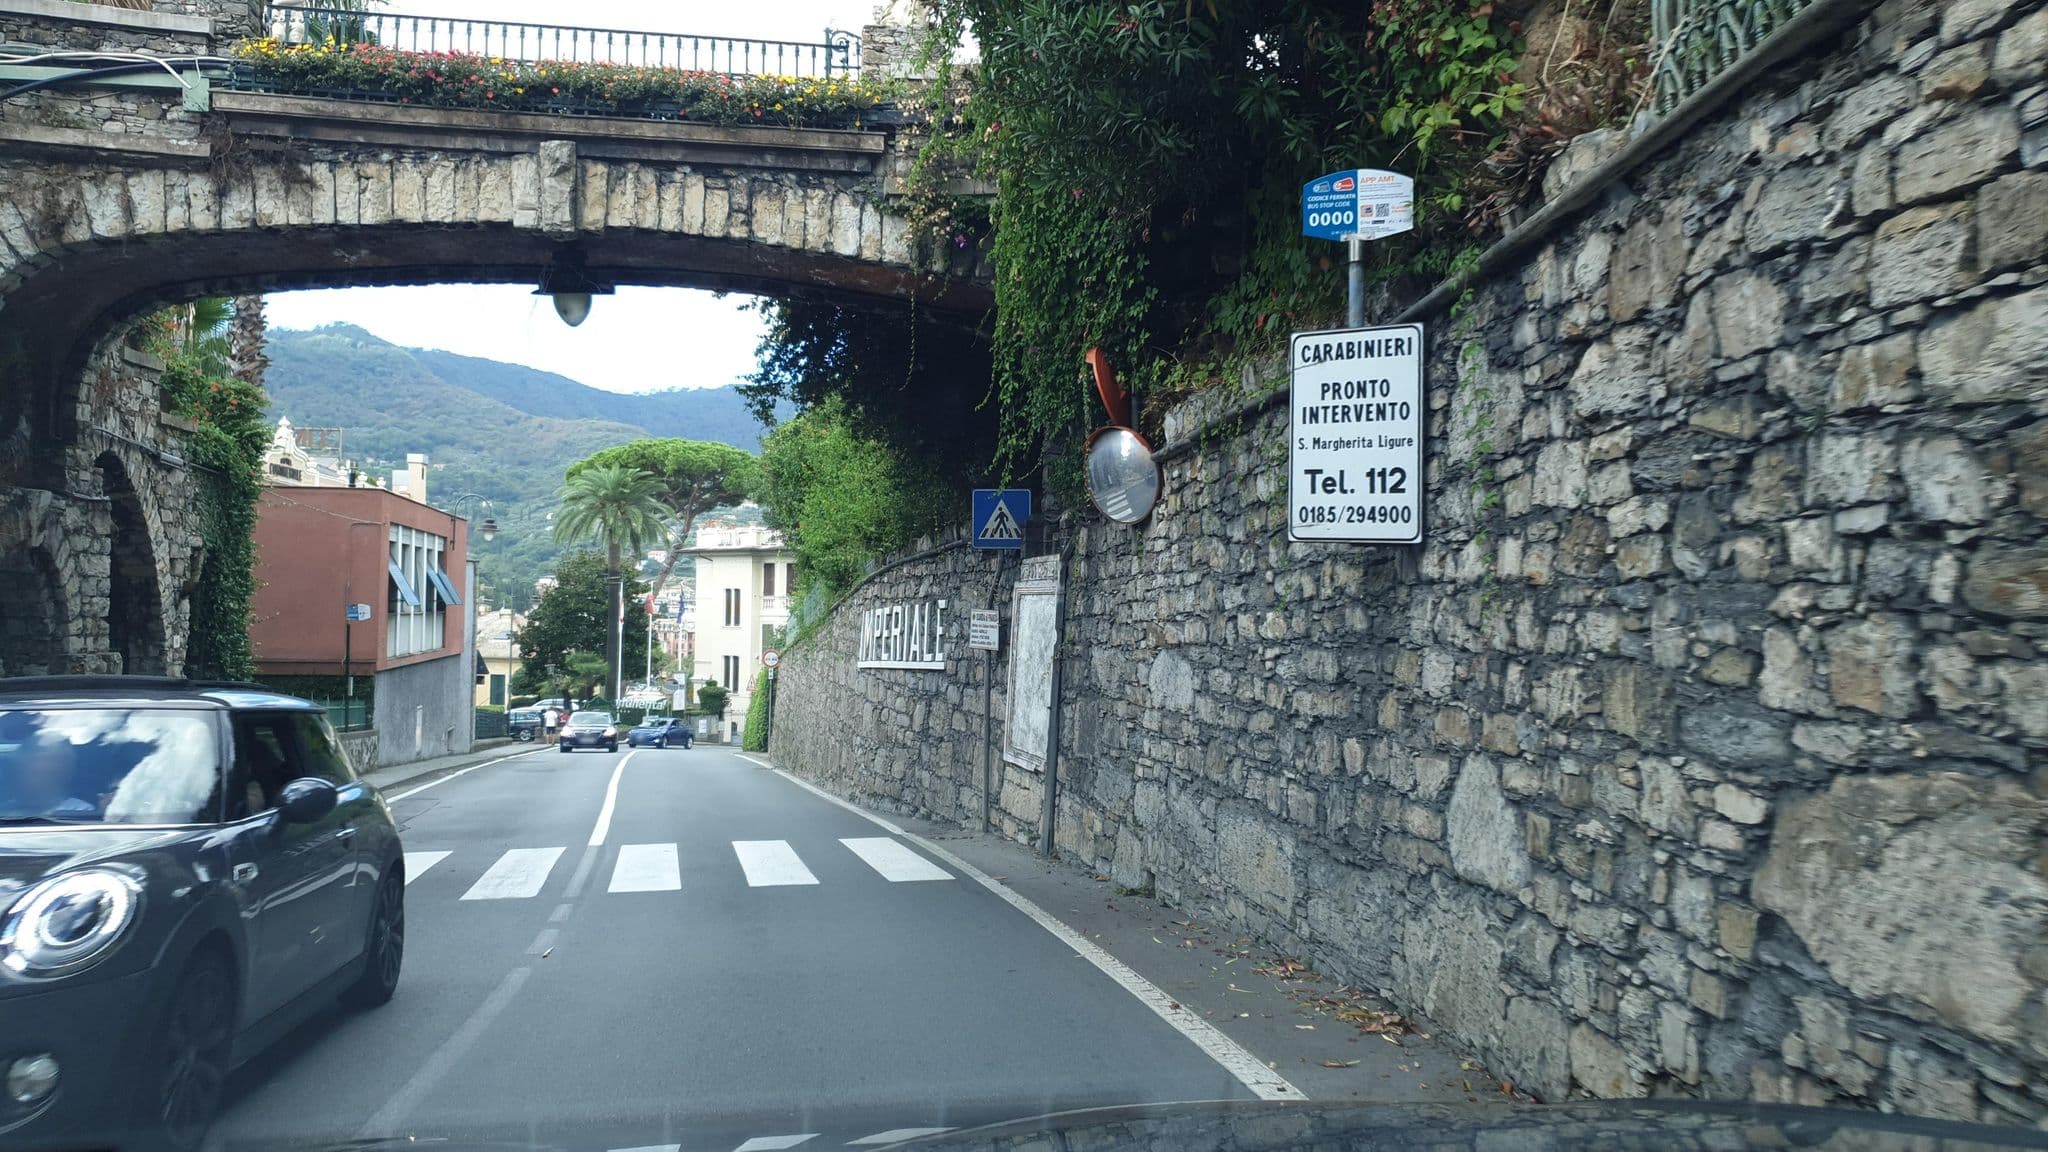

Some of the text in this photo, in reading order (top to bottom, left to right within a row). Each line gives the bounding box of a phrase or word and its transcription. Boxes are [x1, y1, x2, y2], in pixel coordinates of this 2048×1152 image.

[1360, 175, 1396, 184] APP AMT
[1307, 193, 1356, 202] CODICE FERMATA
[1320, 201, 1334, 209] STOP
[1309, 211, 1354, 227] 0000
[1301, 336, 1412, 363] CARABINIERI
[1321, 378, 1390, 401] PRONTO
[1302, 401, 1410, 425] INTERVENTO
[1298, 434, 1414, 451] S. Margherita Ligure
[1304, 466, 1407, 495] Tel. 112
[1299, 504, 1411, 524] 0185/294900
[859, 599, 947, 662] IMPERIALE
